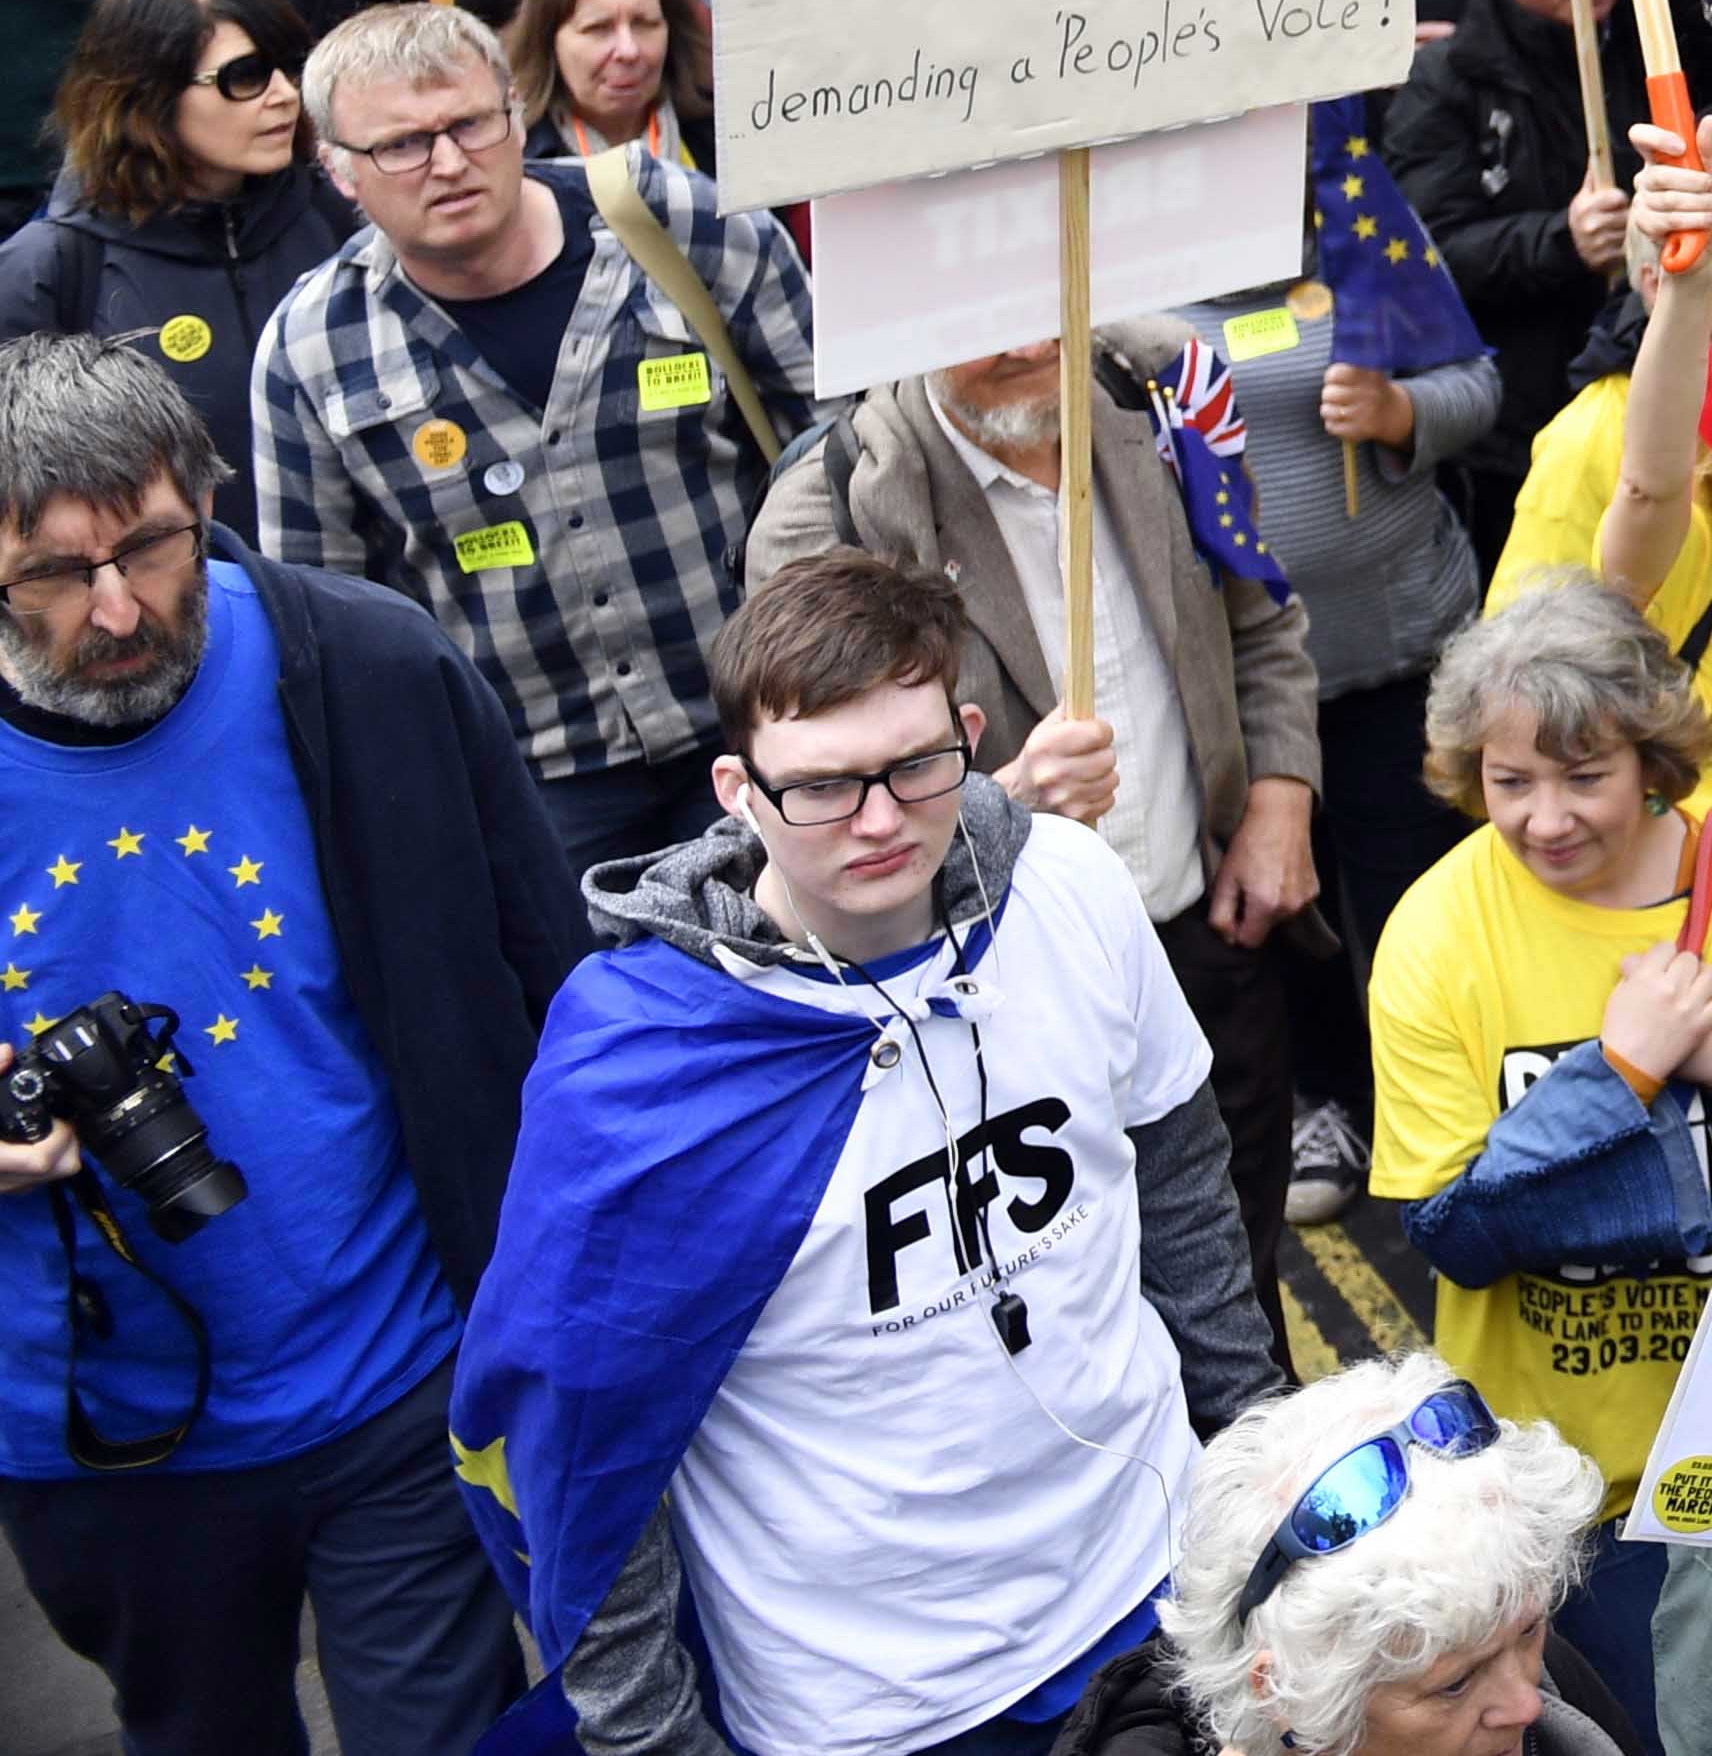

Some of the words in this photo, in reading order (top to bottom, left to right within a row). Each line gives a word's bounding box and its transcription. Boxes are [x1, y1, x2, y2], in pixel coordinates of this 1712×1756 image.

[1009, 52, 1036, 83] a
[872, 1315, 915, 1337] FOR
[923, 1291, 966, 1319] OUR
[1055, 1205, 1089, 1240] SAKE
[1659, 1483, 1684, 1497] THE
[1674, 1473, 1698, 1485] PUT
[1701, 1475, 1712, 1487] IT
